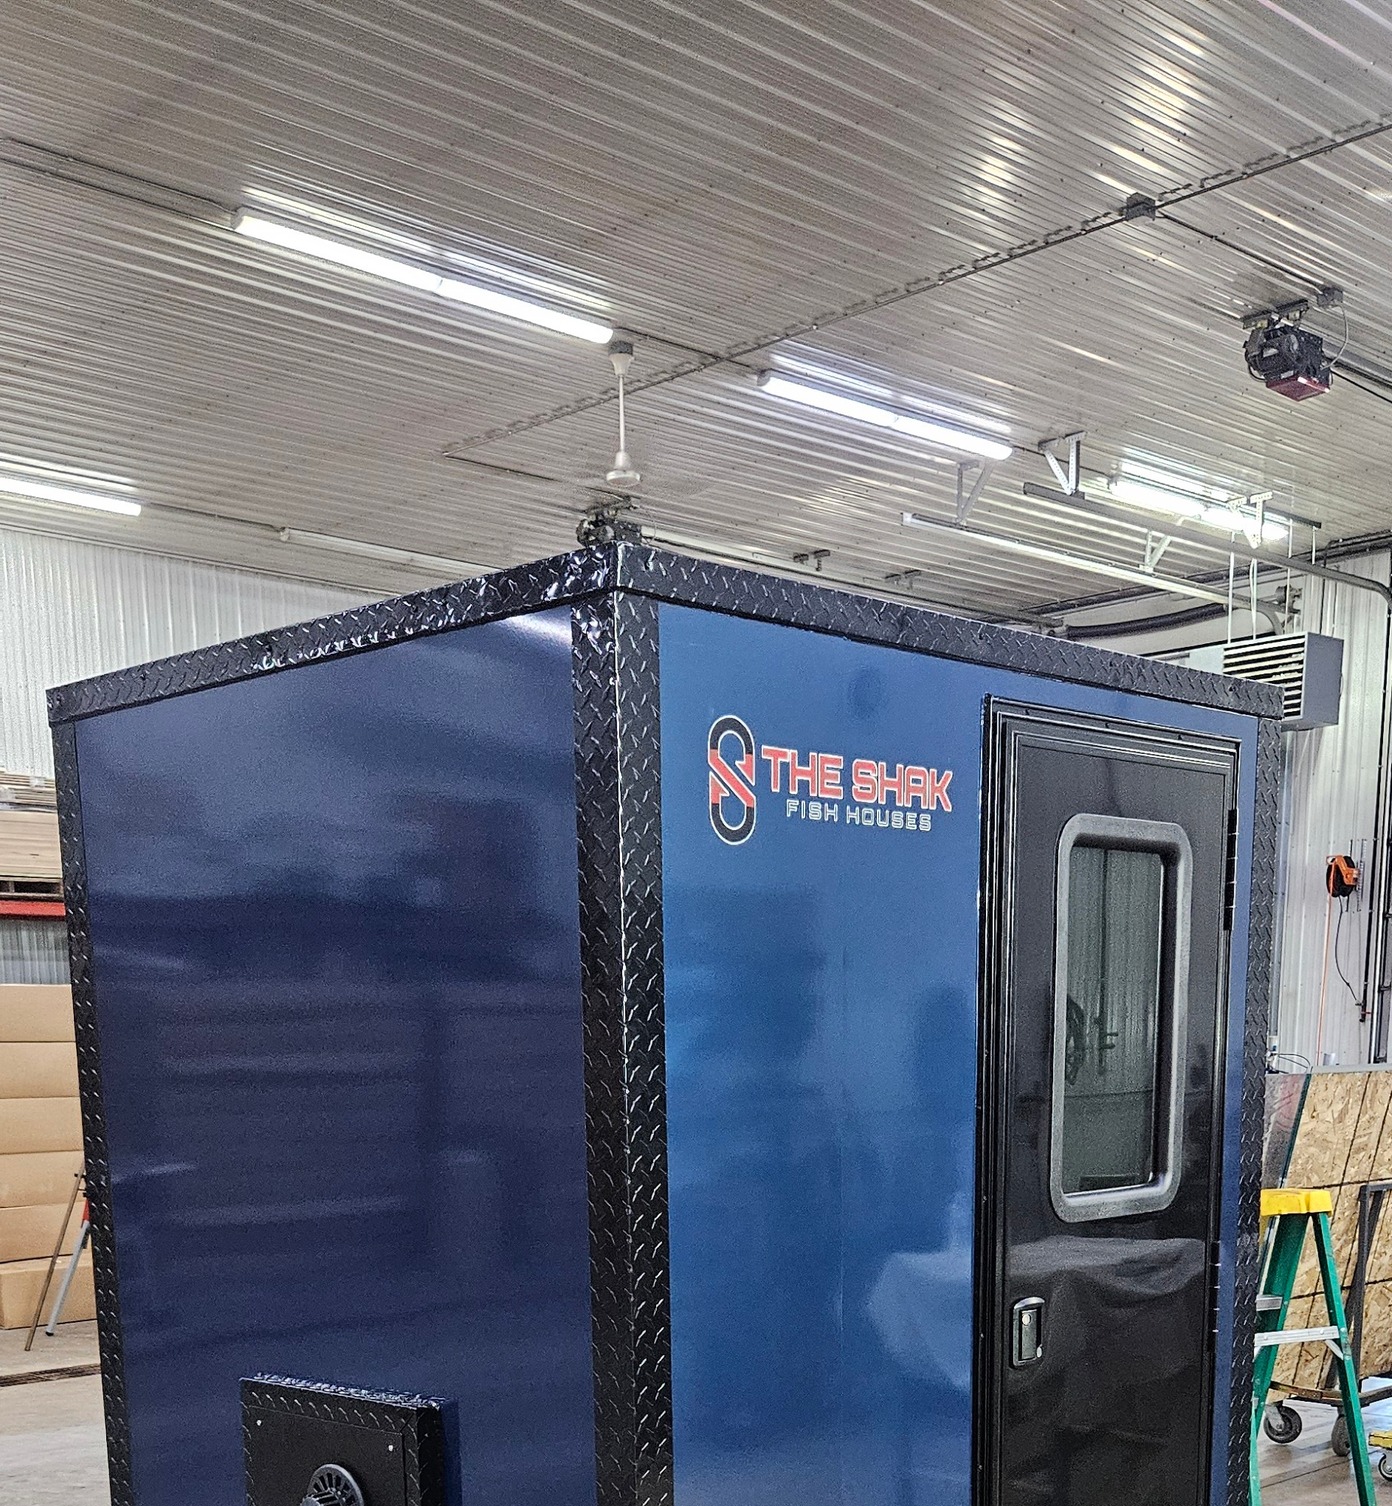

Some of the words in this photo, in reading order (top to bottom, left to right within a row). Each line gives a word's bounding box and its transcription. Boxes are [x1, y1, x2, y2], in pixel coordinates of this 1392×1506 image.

[761, 745, 843, 799] THE
[852, 759, 953, 812] SHAK
[786, 799, 838, 822] FISH
[846, 806, 932, 831] HOUSES
